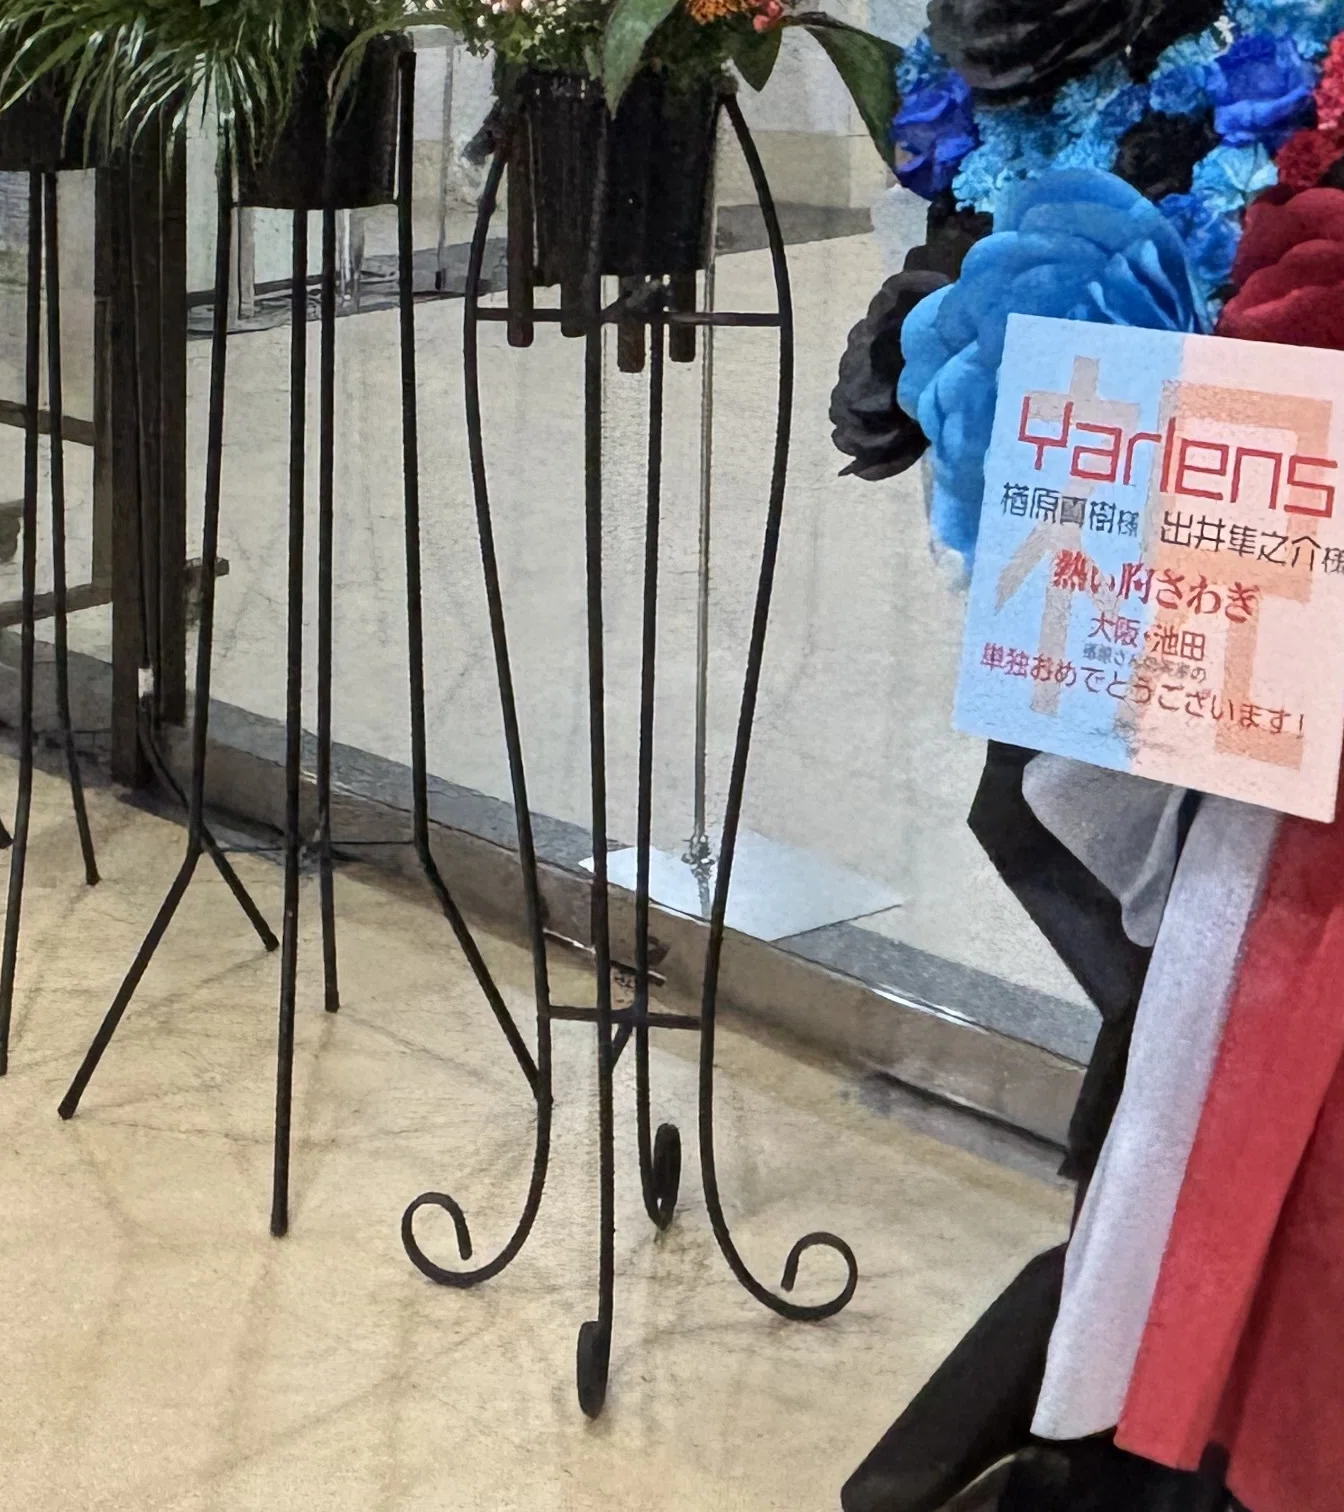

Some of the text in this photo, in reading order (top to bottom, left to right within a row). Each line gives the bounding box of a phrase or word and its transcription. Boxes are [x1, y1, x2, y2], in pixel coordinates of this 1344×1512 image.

[1017, 396, 1339, 519] Yarlens
[1052, 549, 1260, 624] 熱い胸さわぎ
